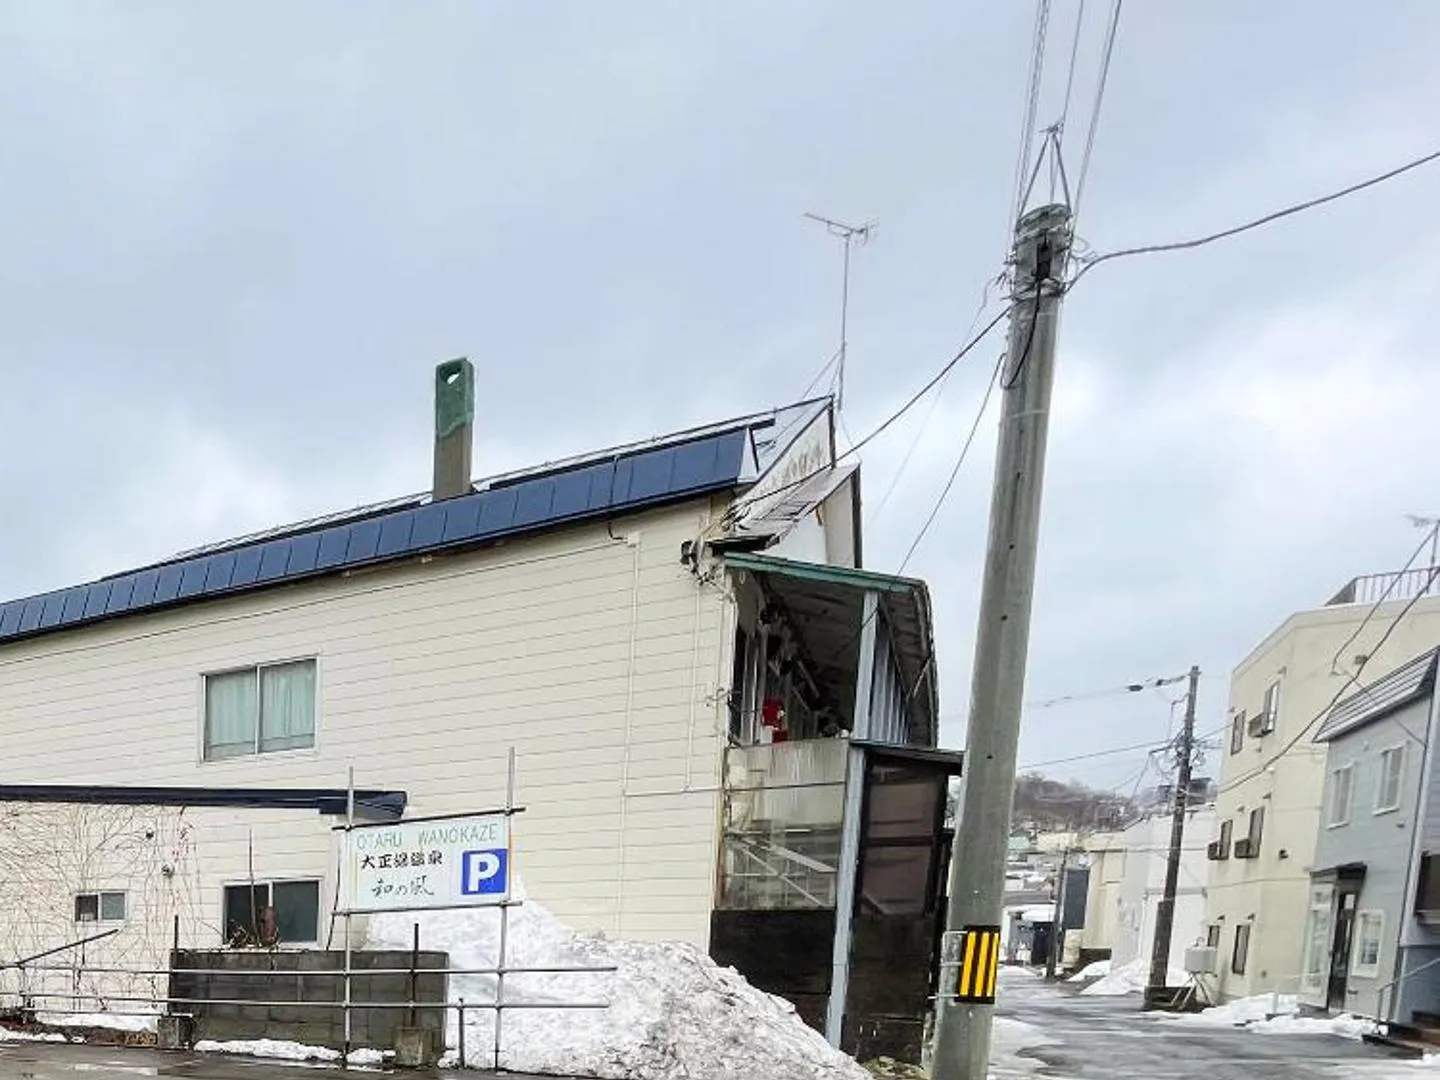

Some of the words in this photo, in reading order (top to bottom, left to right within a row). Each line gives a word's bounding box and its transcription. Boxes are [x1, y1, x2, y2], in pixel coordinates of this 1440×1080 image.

[357, 831, 402, 849] OTARU
[418, 823, 498, 846] WANOKAZE
[468, 853, 500, 892] P
